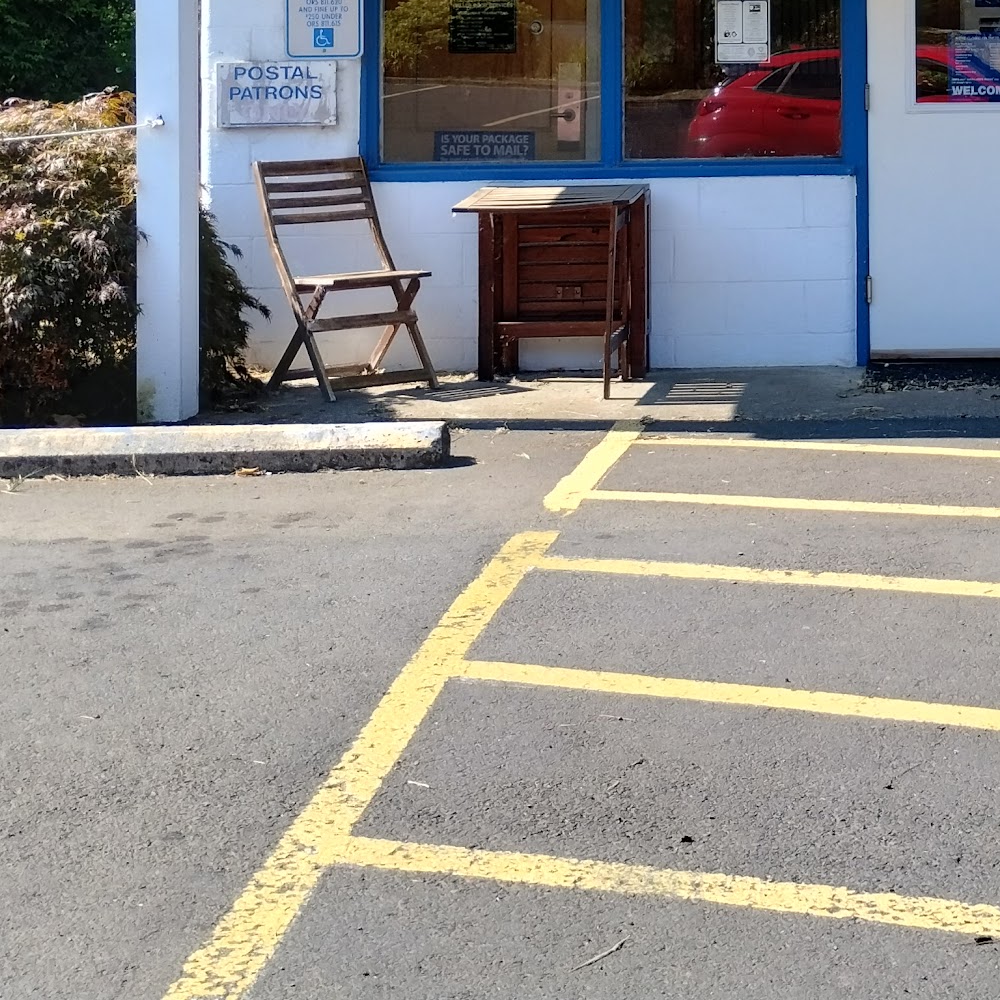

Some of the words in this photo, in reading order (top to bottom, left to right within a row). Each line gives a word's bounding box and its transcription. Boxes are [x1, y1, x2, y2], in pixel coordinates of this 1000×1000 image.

[234, 65, 319, 81] POSTAL
[229, 85, 323, 101] PATRONS
[440, 134, 449, 144] IS
[451, 134, 480, 144] YOUR
[482, 134, 529, 144] PACKAGE
[440, 144, 471, 156] SAFE
[473, 144, 491, 156] TO
[493, 144, 529, 156] MAIL?
